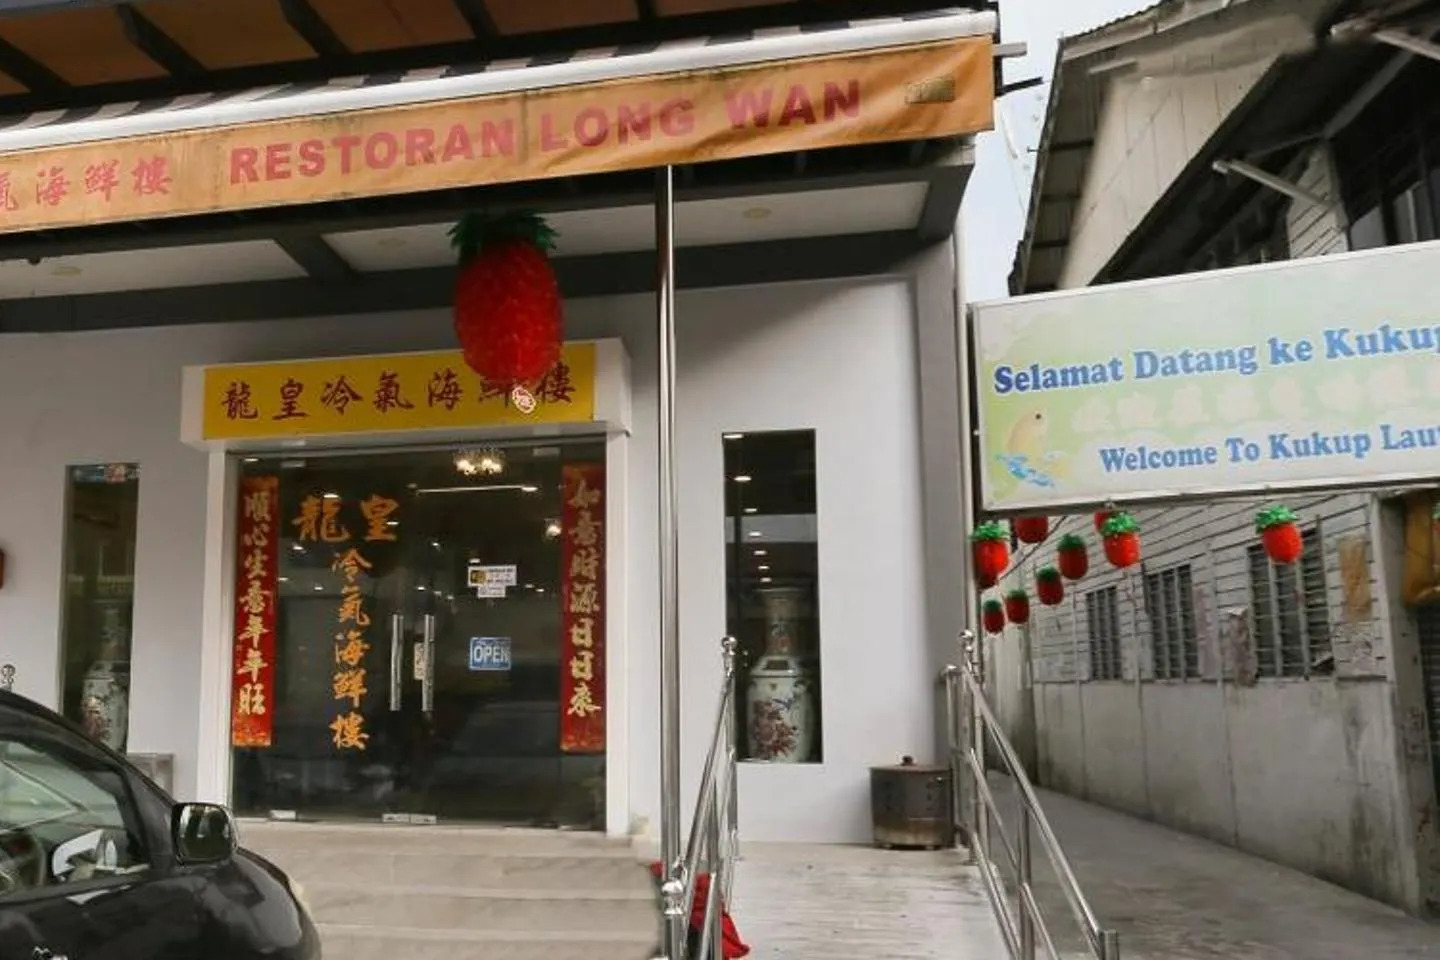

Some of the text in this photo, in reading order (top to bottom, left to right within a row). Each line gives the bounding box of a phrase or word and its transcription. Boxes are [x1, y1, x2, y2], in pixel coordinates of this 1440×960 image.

[229, 78, 861, 186] RESTORAN LONG WAN
[993, 322, 1440, 394] Selamat Datang ke Kuku
[1099, 423, 1440, 473] Welcome To Kukup Lau
[291, 494, 400, 543] 龍皇
[473, 645, 510, 663] OPEN
